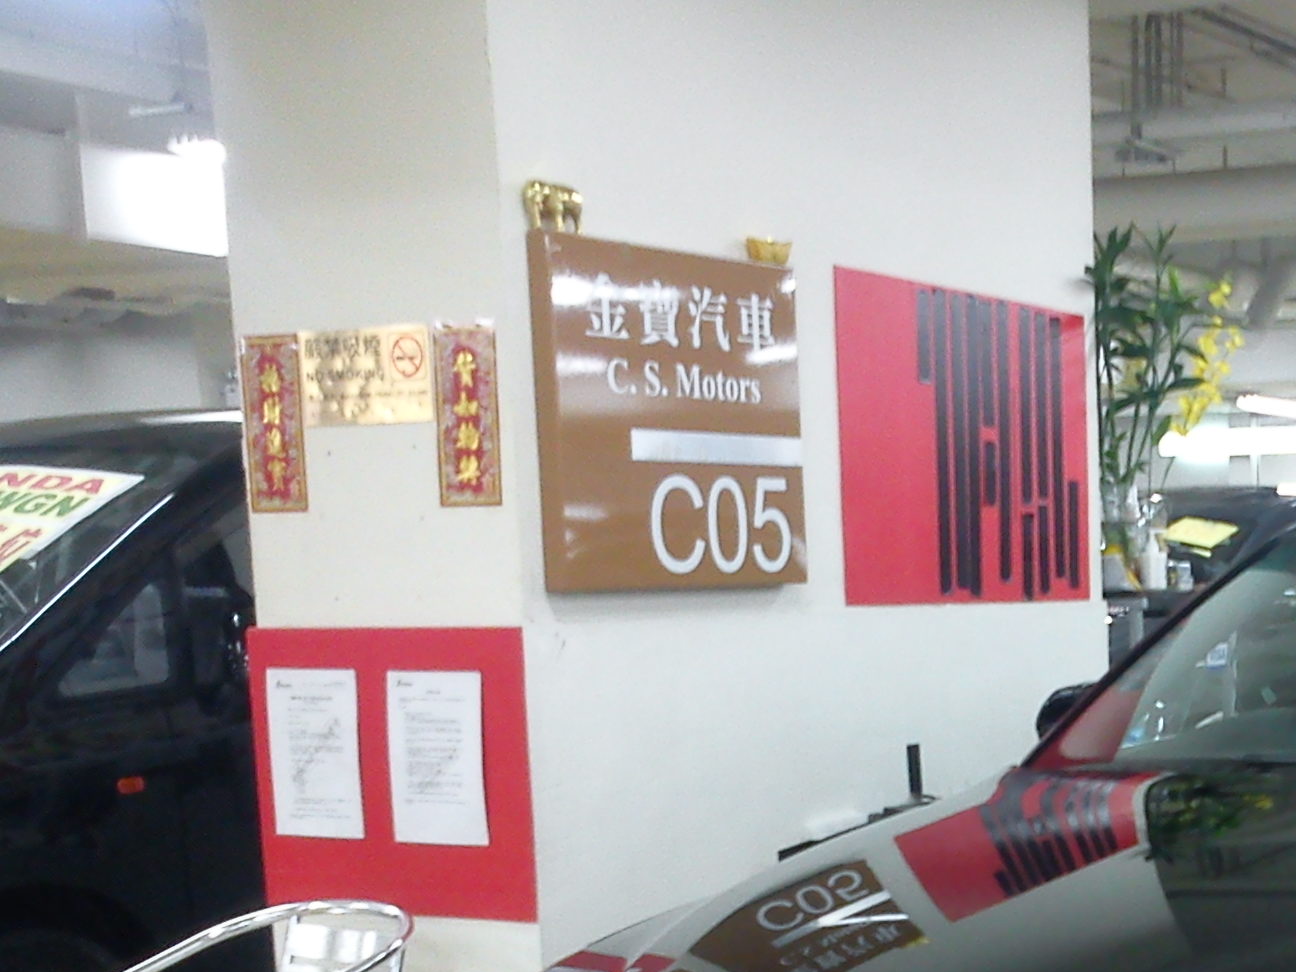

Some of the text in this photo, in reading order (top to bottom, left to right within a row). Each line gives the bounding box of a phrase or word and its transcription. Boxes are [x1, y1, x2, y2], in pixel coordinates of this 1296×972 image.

[584, 272, 776, 352] 金寶汽車
[606, 357, 762, 405] C. S. Motors
[650, 473, 792, 574] C05
